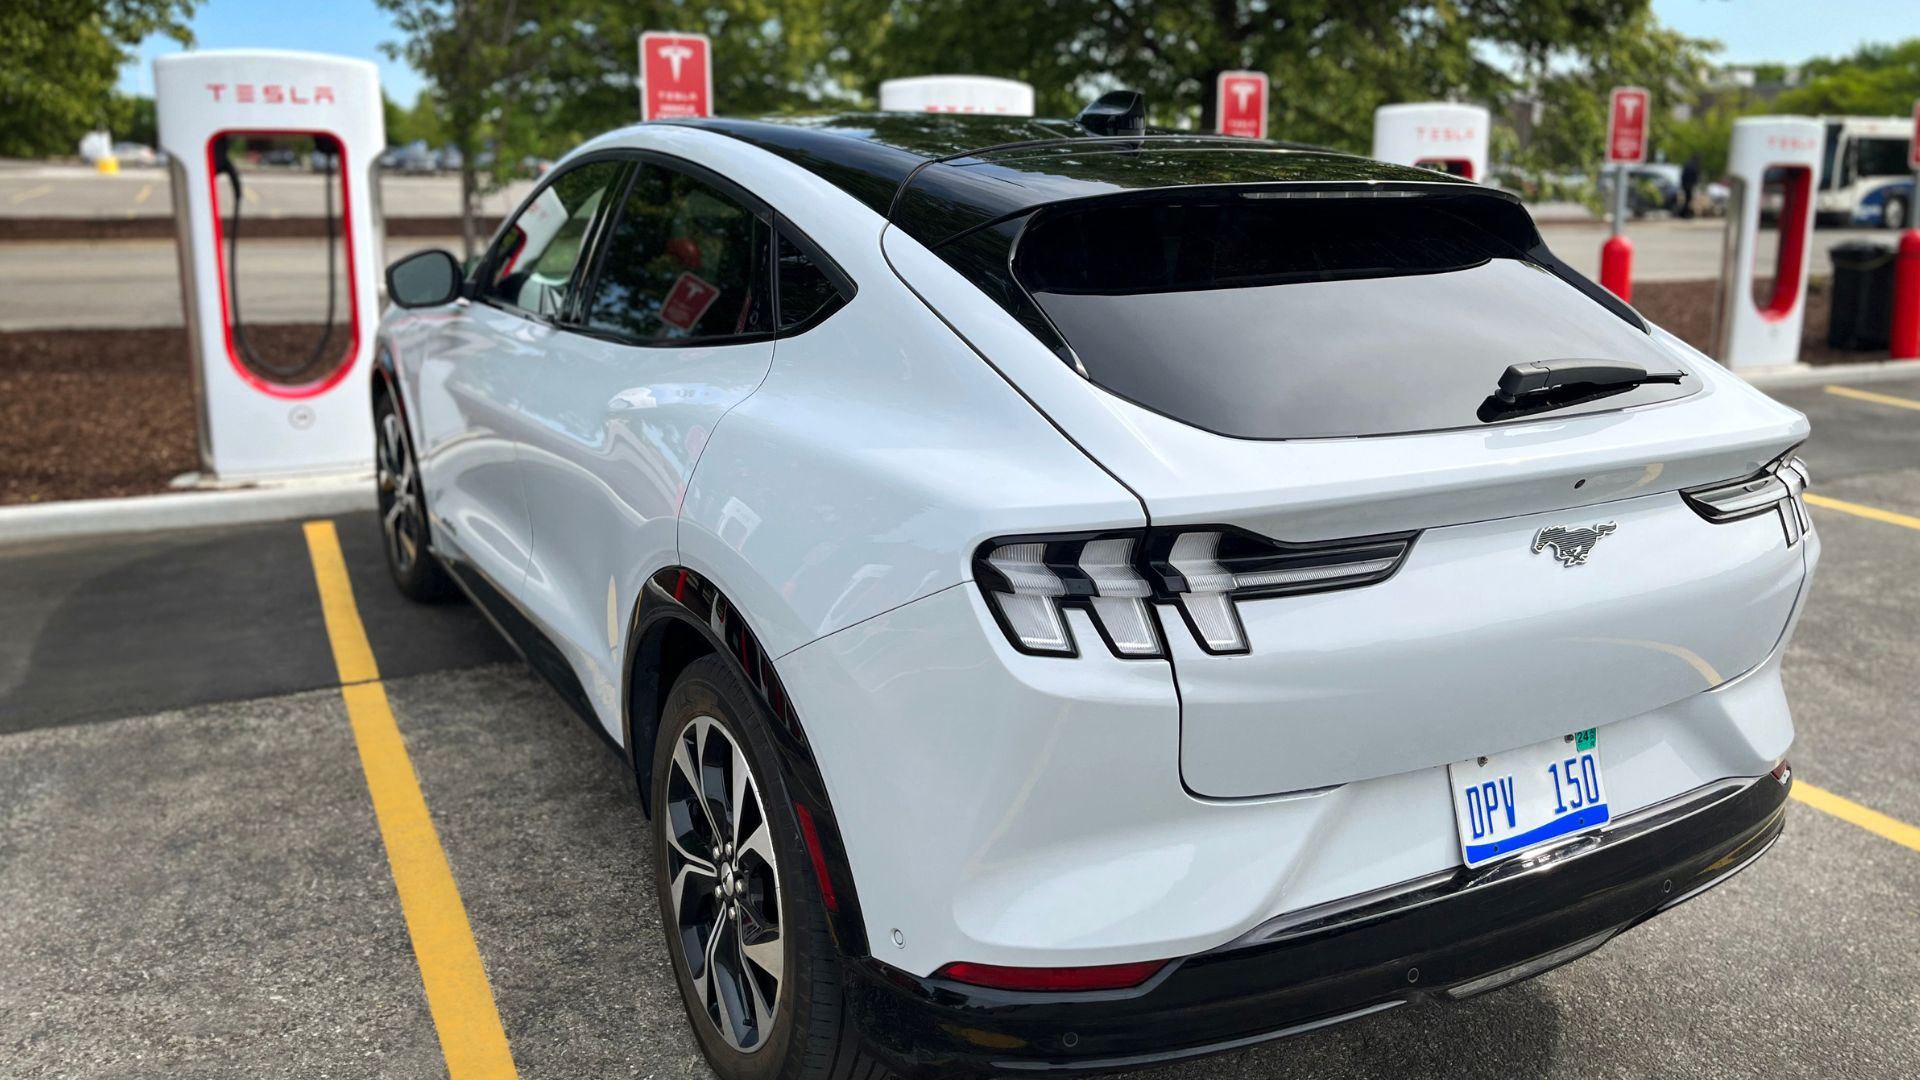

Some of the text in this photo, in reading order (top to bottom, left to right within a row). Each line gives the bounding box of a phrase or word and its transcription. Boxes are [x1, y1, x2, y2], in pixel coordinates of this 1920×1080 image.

[206, 83, 335, 104] TESLA
[1414, 126, 1475, 142] TESLA
[1577, 730, 1589, 743] 24
[1466, 754, 1600, 839] DPV 150
